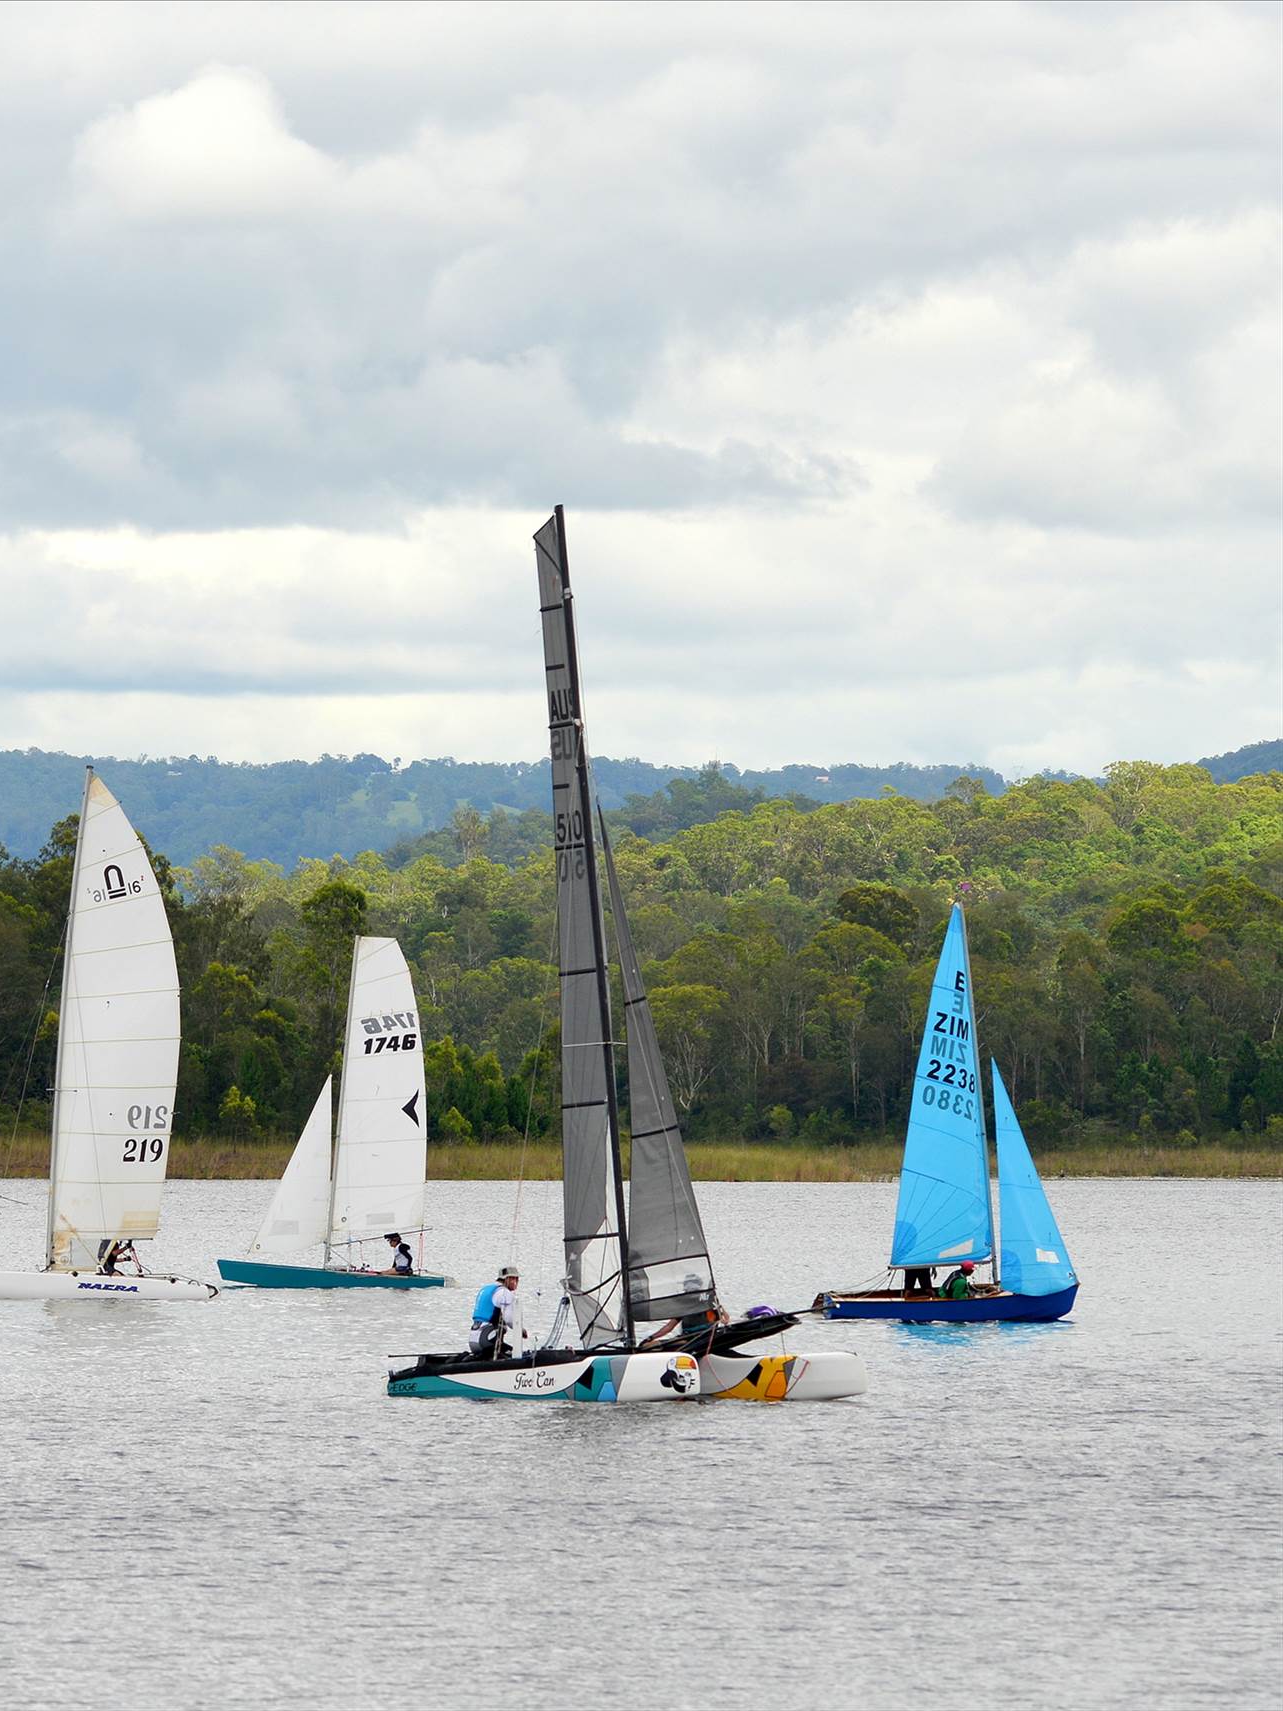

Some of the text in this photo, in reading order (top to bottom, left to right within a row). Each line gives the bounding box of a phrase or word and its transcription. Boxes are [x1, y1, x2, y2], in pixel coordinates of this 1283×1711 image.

[955, 970, 965, 993] E
[934, 1011, 969, 1042] ZIM
[363, 1033, 416, 1055] 1746
[927, 1059, 976, 1094] 2238
[122, 1138, 163, 1163] 219
[536, 1370, 556, 1389] Can
